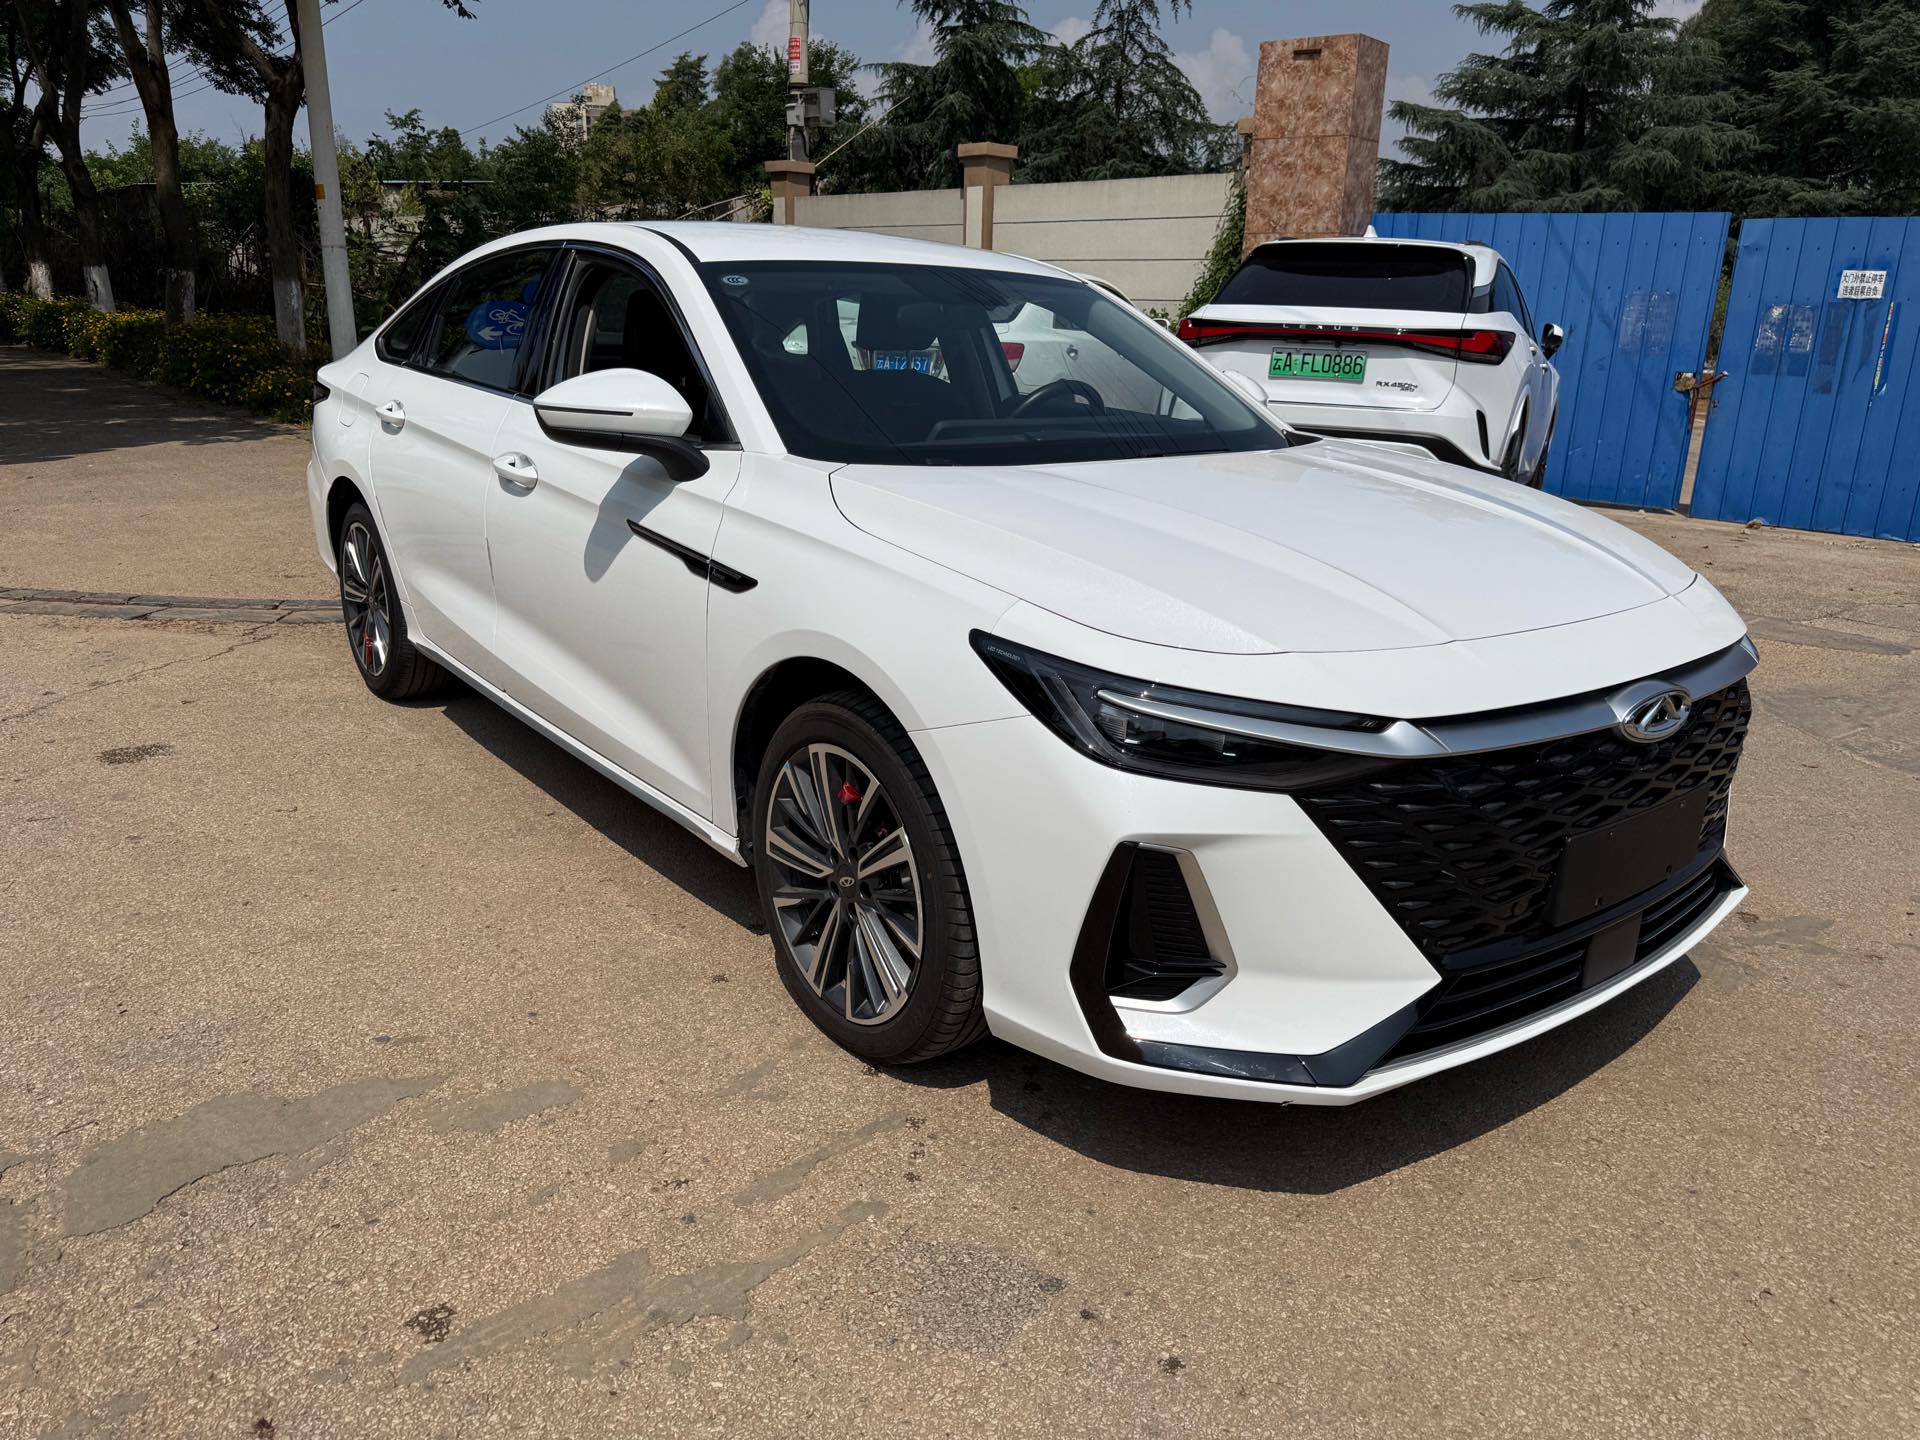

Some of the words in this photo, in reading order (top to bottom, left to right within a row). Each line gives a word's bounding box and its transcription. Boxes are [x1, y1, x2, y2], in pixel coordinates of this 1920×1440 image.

[1842, 272, 1884, 283] 大门外禁止停车
[1842, 285, 1878, 296] 违者后果自负
